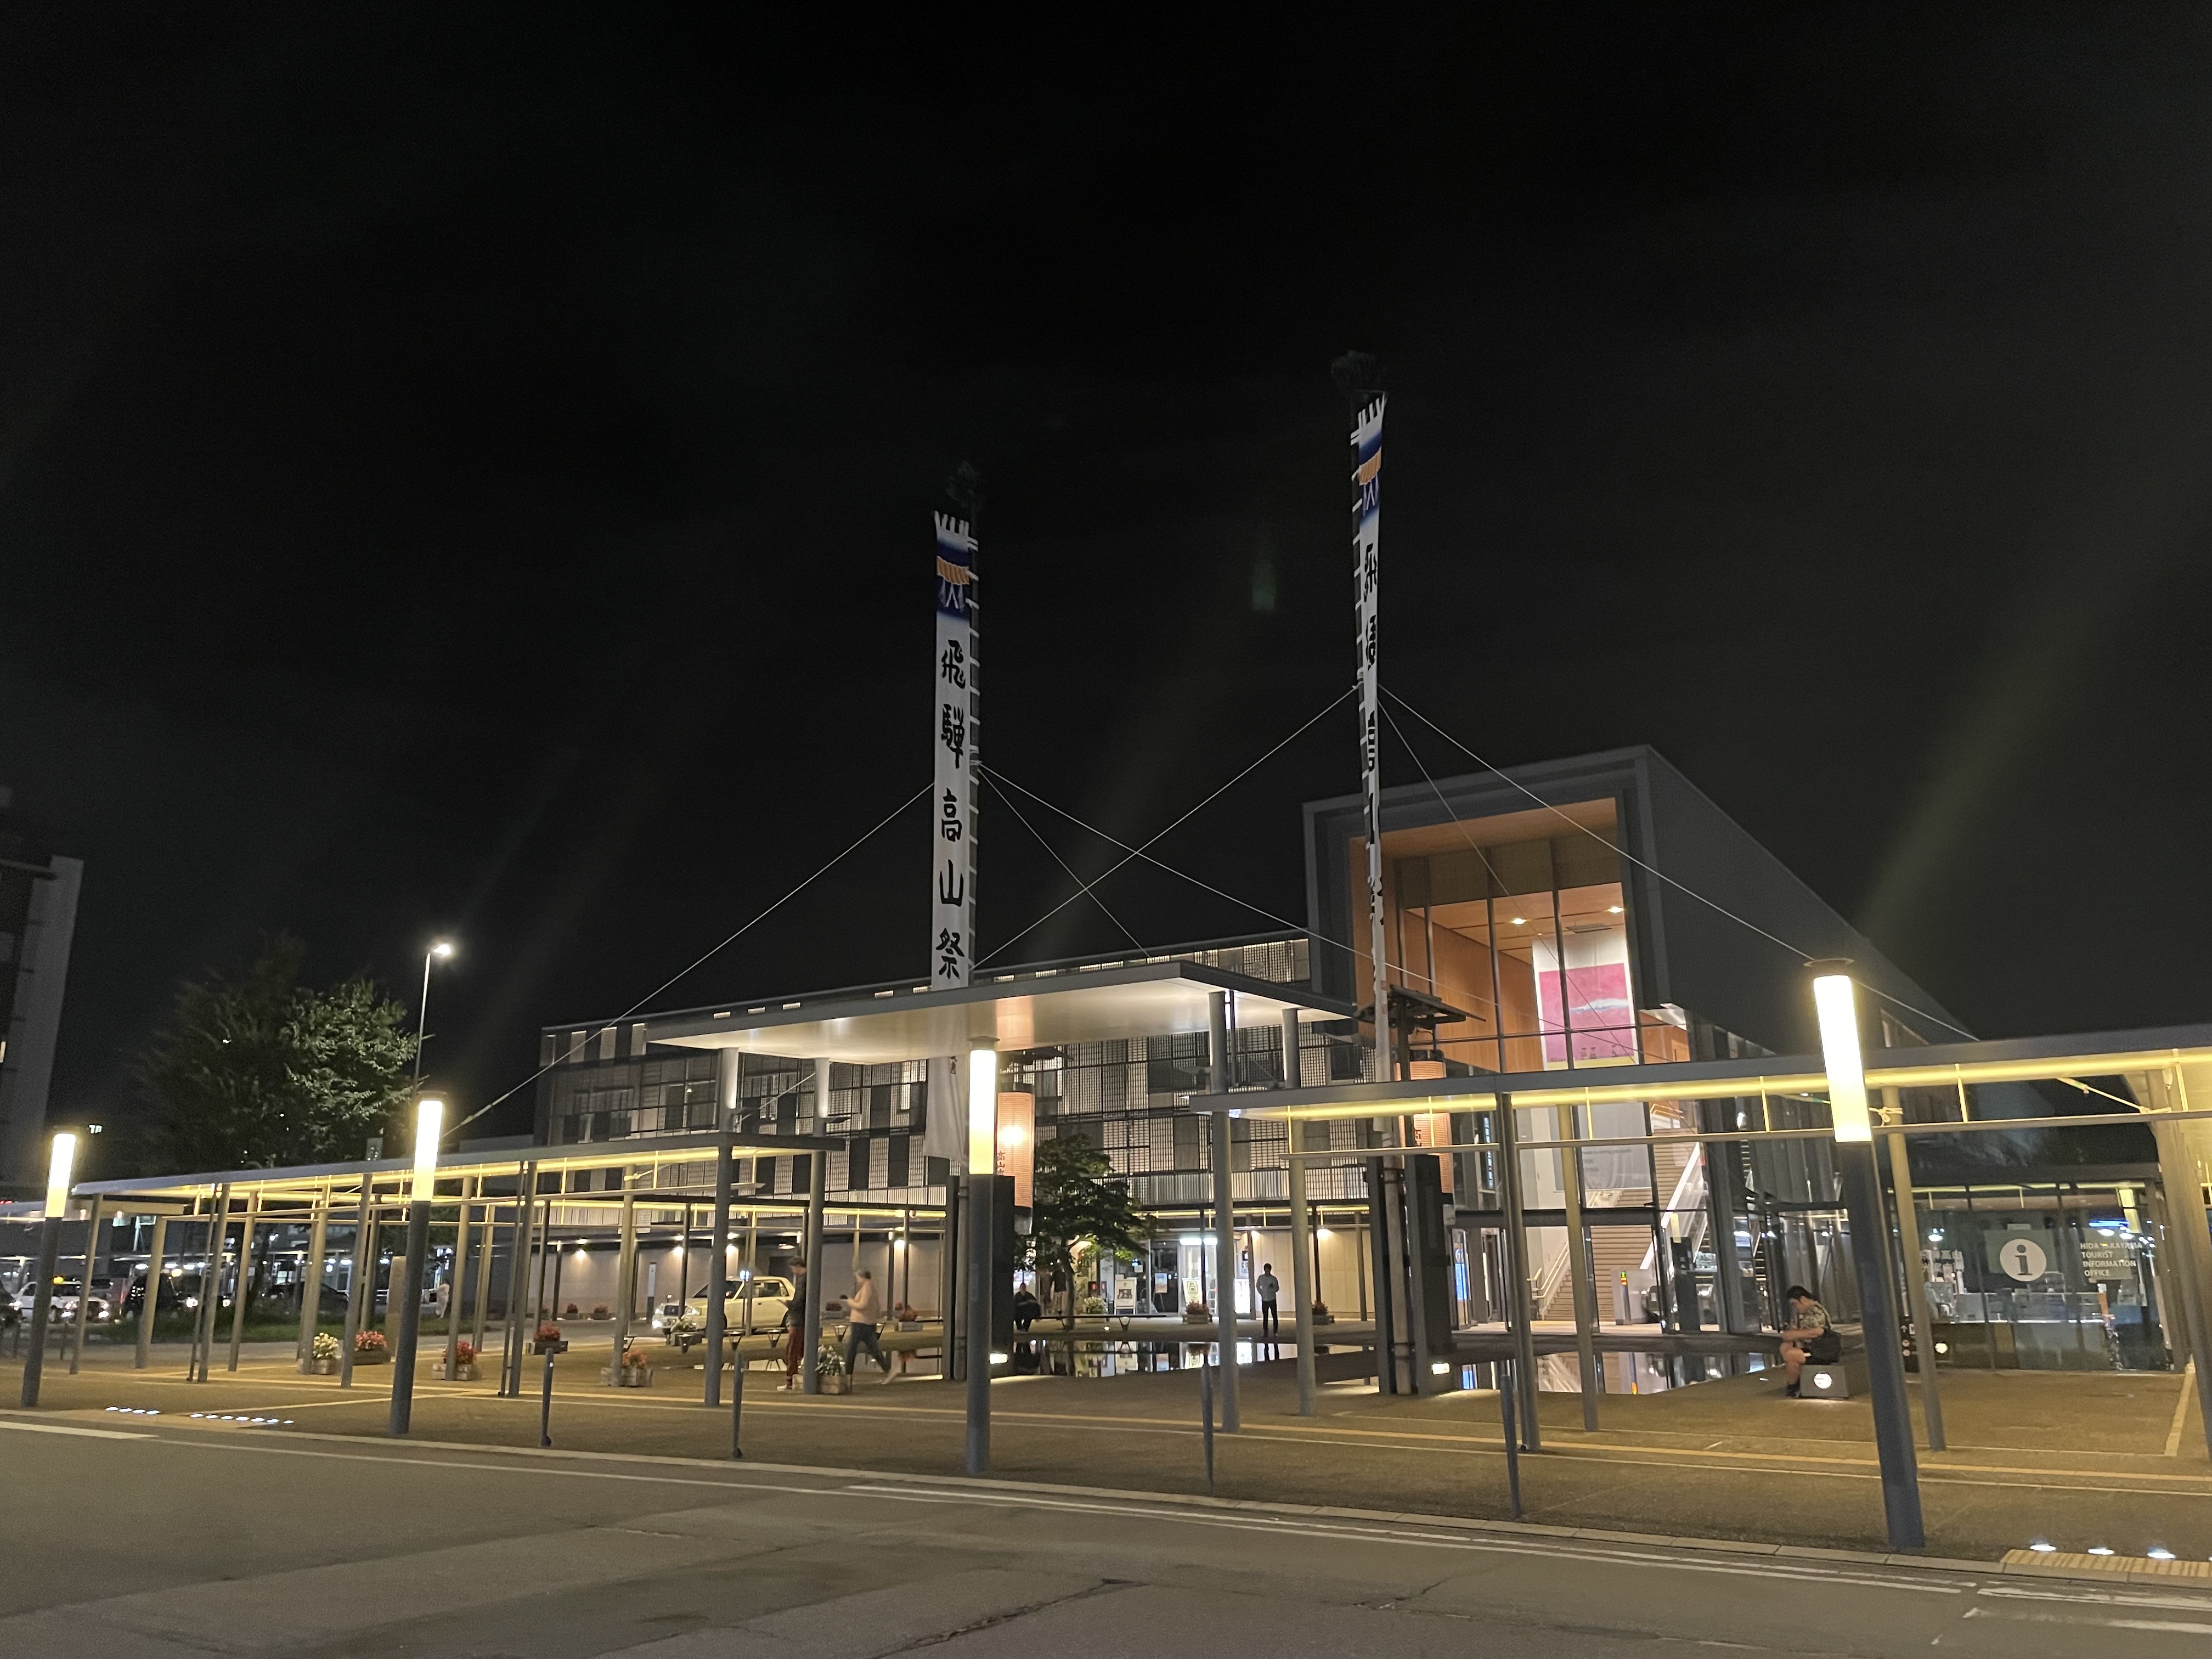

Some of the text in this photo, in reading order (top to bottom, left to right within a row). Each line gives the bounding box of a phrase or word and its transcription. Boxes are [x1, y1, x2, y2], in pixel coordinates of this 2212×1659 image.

[936, 640, 966, 980] 飛騨高山祭
